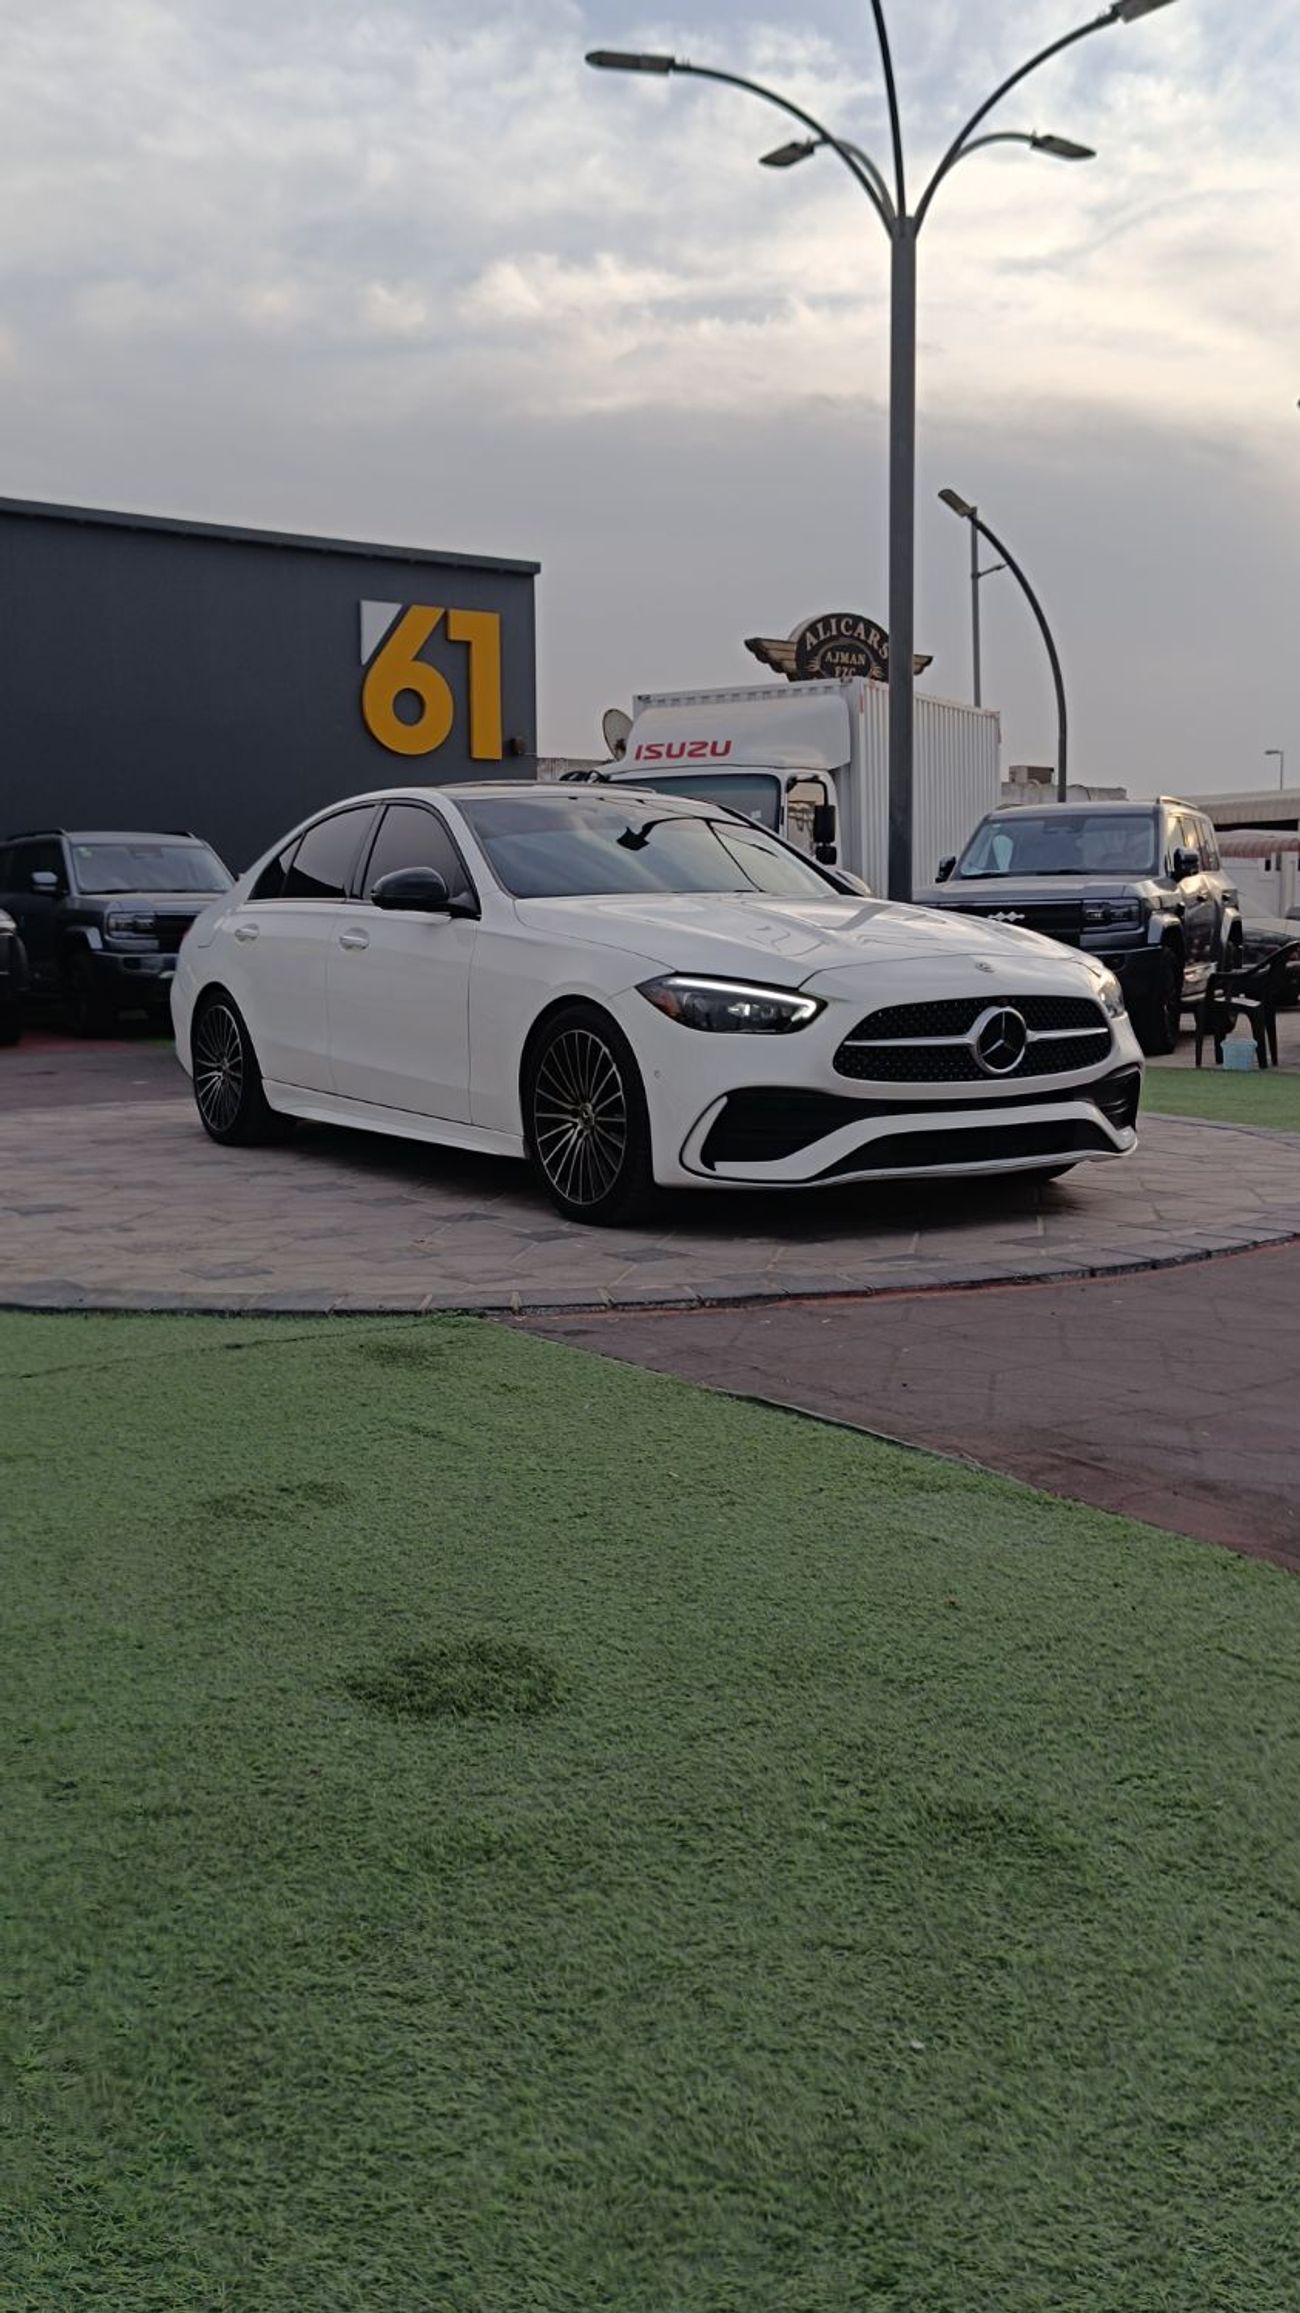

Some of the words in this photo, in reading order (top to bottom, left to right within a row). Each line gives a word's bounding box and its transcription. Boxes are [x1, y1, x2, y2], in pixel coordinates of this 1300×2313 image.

[825, 651, 866, 665] AJMAN
[362, 603, 503, 760] 61
[634, 740, 732, 760] ISUZU
